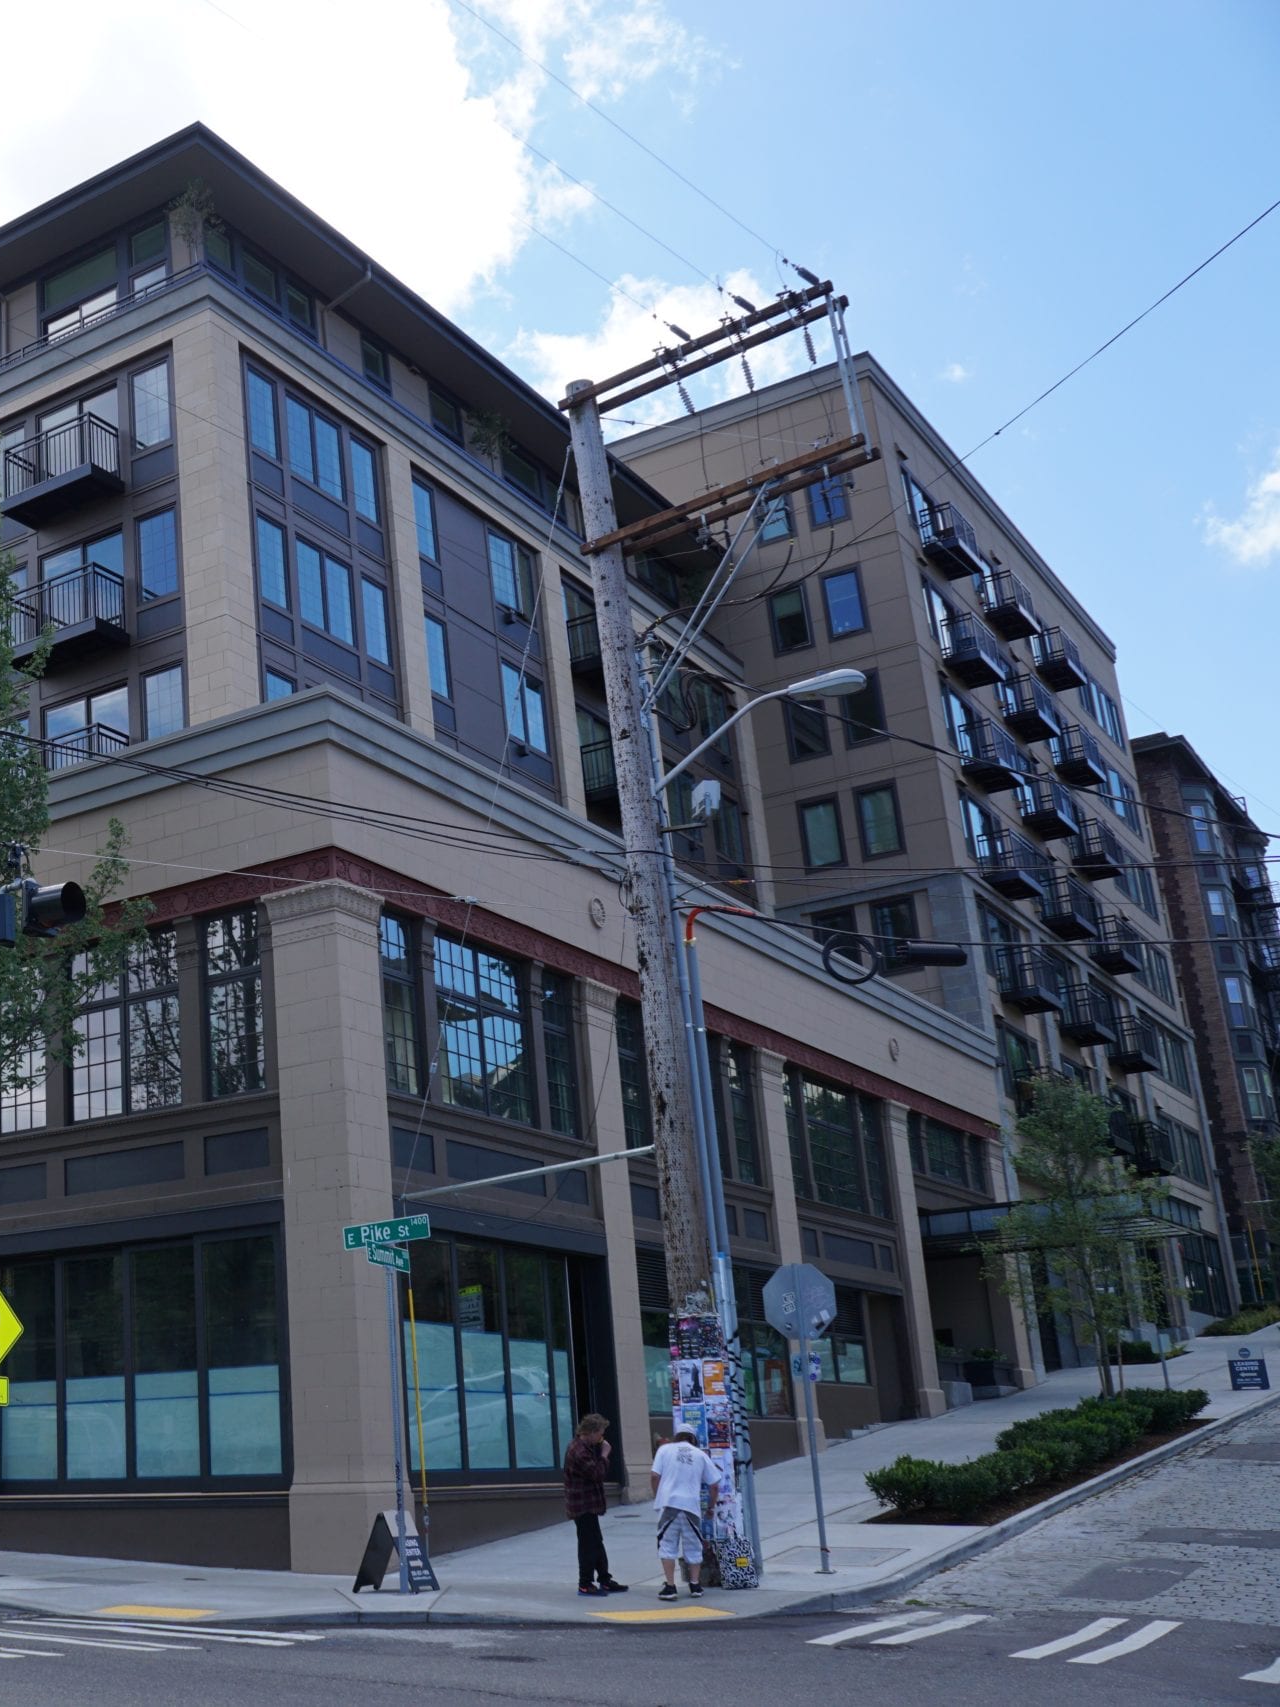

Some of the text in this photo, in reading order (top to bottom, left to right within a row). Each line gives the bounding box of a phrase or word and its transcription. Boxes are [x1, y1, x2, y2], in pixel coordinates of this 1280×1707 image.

[410, 1216, 427, 1226] 1400
[347, 1224, 410, 1245] E Pike St
[368, 1248, 372, 1260] E
[372, 1244, 395, 1264] Summit
[395, 1255, 404, 1268] Ave
